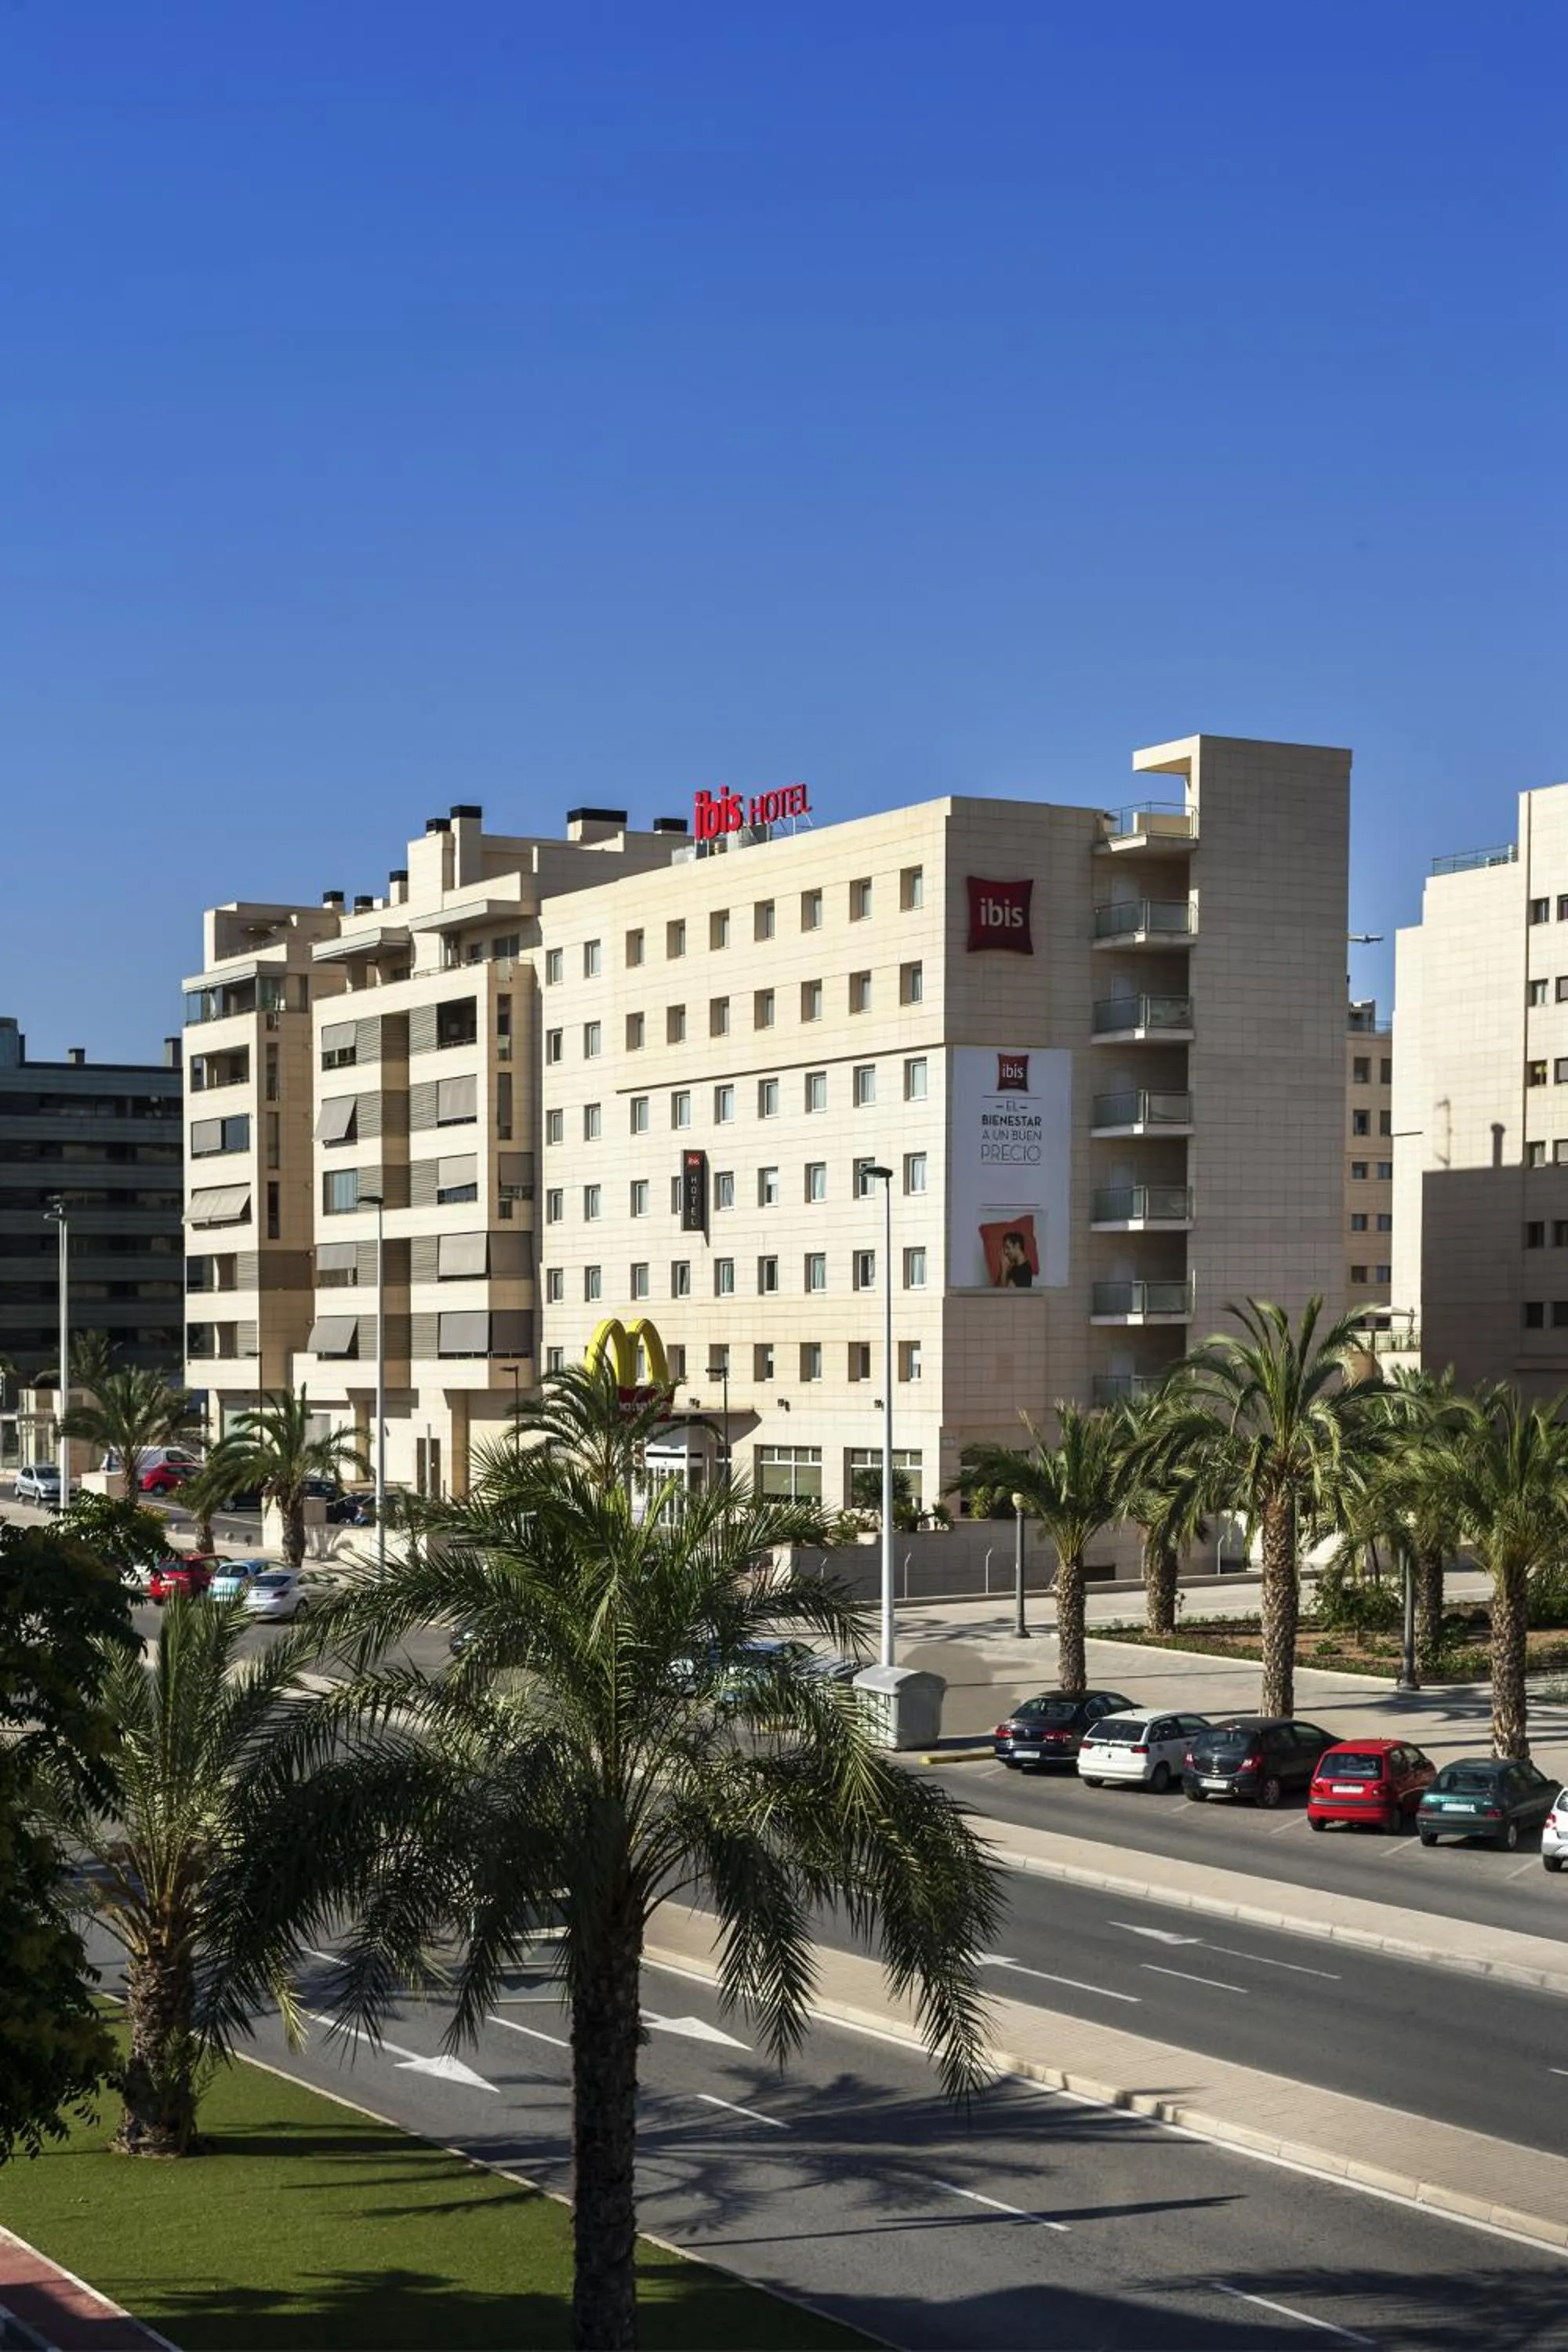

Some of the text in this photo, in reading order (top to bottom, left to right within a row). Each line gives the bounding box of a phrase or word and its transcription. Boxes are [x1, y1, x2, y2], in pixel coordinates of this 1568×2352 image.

[694, 783, 813, 840] ibis HOTEL
[980, 898, 1023, 927] ibis
[1002, 1063, 1023, 1079] ibis
[982, 1114, 1042, 1127] BIENESTAR
[982, 1130, 1042, 1142] A UN BUEN
[981, 1144, 1041, 1162] PRECIO
